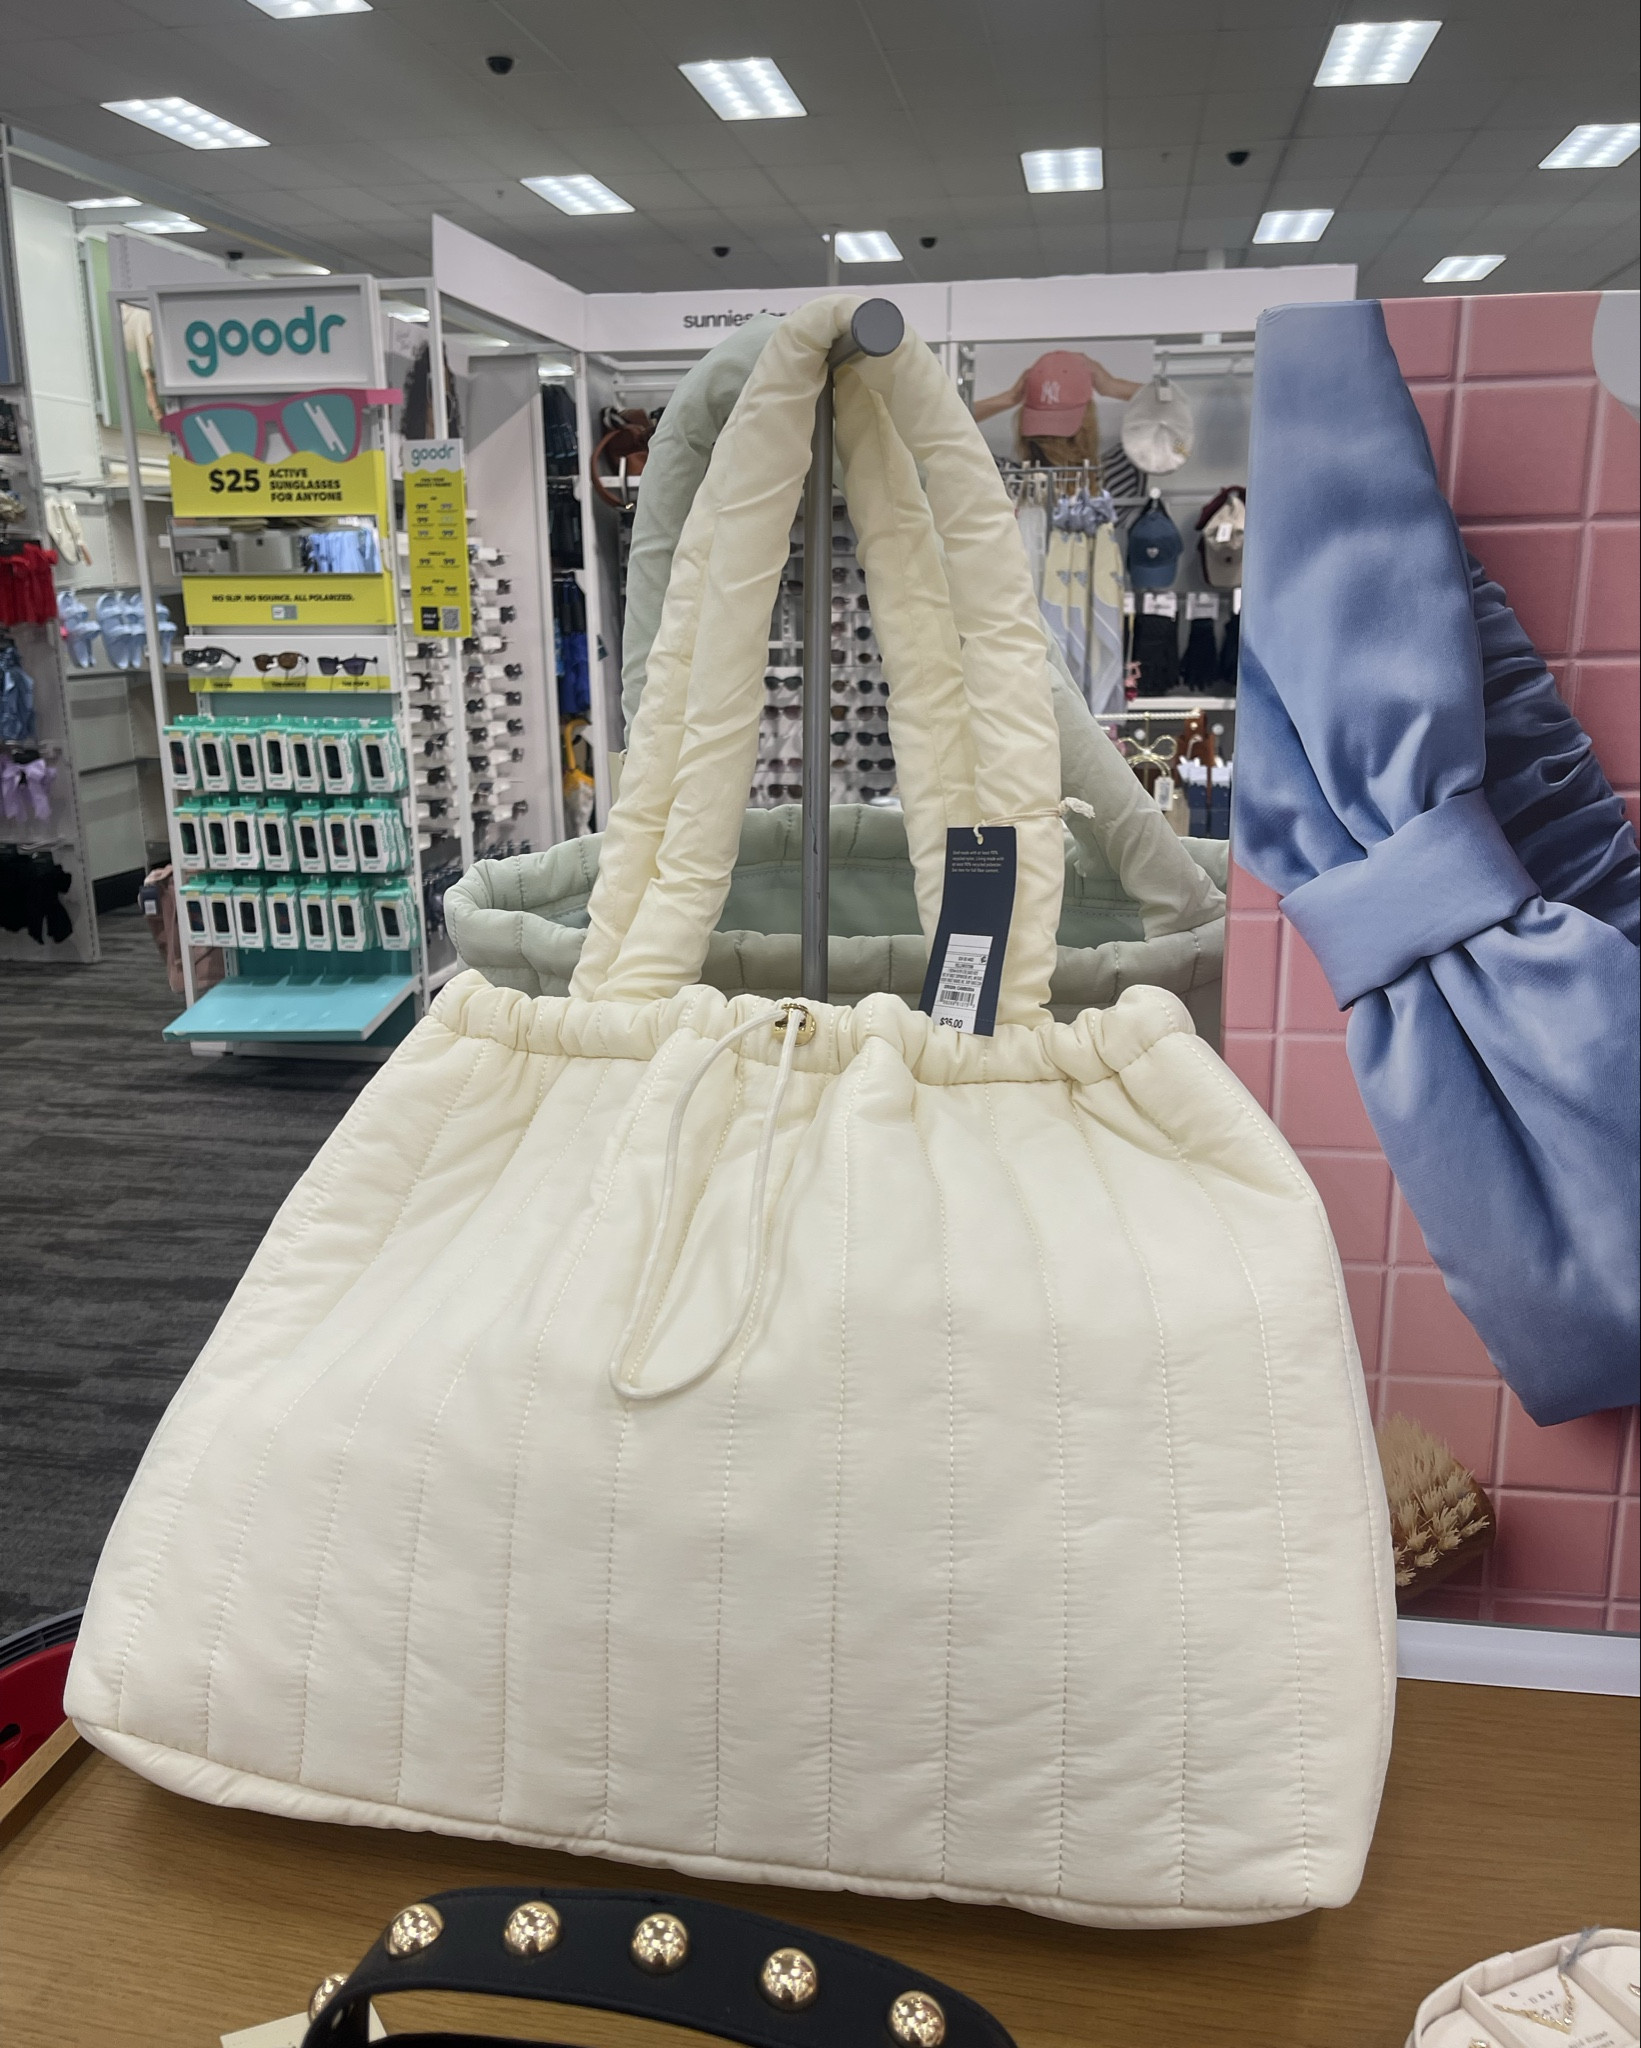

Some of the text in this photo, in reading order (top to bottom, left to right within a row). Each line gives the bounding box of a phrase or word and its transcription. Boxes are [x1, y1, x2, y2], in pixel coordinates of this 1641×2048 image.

[185, 305, 346, 378] goodr
[411, 444, 455, 467] goodr
[269, 468, 308, 478] ACTIVE
[209, 468, 260, 493] $25
[270, 479, 341, 490] SUNGLASSES
[271, 491, 343, 502] FOR ANYONE
[258, 594, 292, 602] BOUNCE.
[294, 594, 308, 602] ALL
[309, 594, 355, 602] POLARIZED.
[940, 1017, 963, 1029] $35.00
